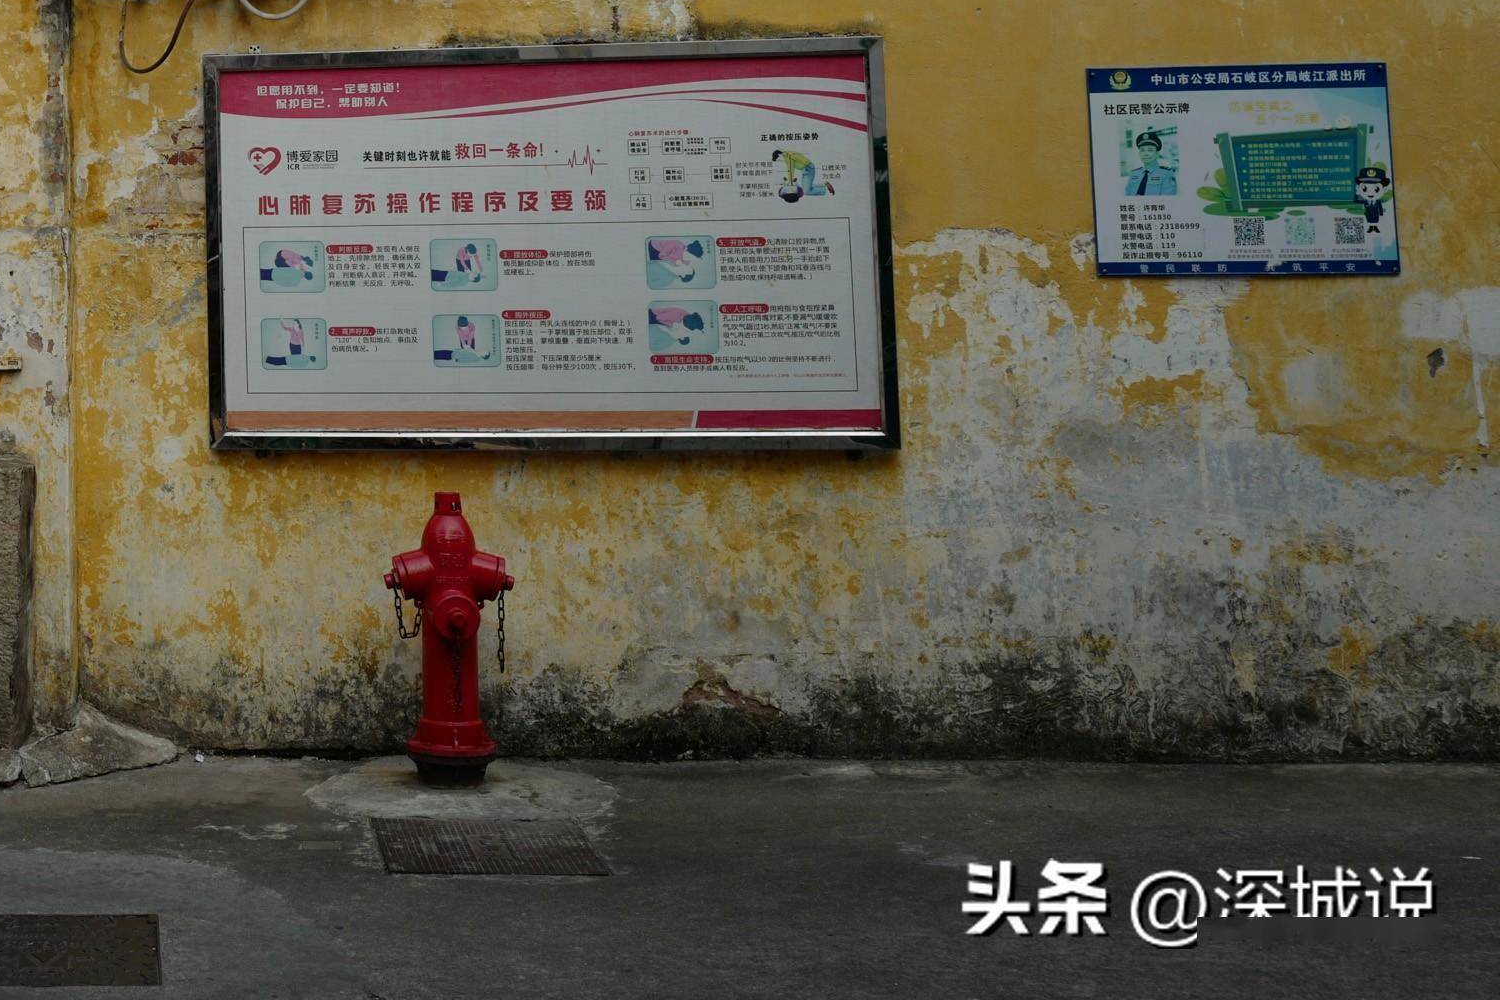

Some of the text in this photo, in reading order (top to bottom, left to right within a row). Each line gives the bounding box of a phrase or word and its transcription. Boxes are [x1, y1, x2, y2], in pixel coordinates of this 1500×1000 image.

[1150, 69, 1367, 87] 中山市公安局石岐区分局岐江派出所
[256, 82, 401, 97] 但愿用不到，一定要知道！
[275, 96, 389, 110] 保护自己，帮助别人
[1102, 102, 1190, 116] 社区民警公示牌
[760, 132, 819, 143] 正确的按压姿势
[286, 149, 339, 163] 博爱家园
[362, 149, 452, 163] 关键时刻也许就能
[454, 141, 545, 160] 救回一条命！
[287, 163, 301, 171] ICR
[258, 190, 608, 216] 心肺复苏操作程序及要领
[1120, 222, 1200, 231] 联系电话：23186999
[1121, 232, 1175, 241] 报警电话：110
[1122, 242, 1176, 250] 火警电话：119
[1139, 263, 1228, 274] 警民联防
